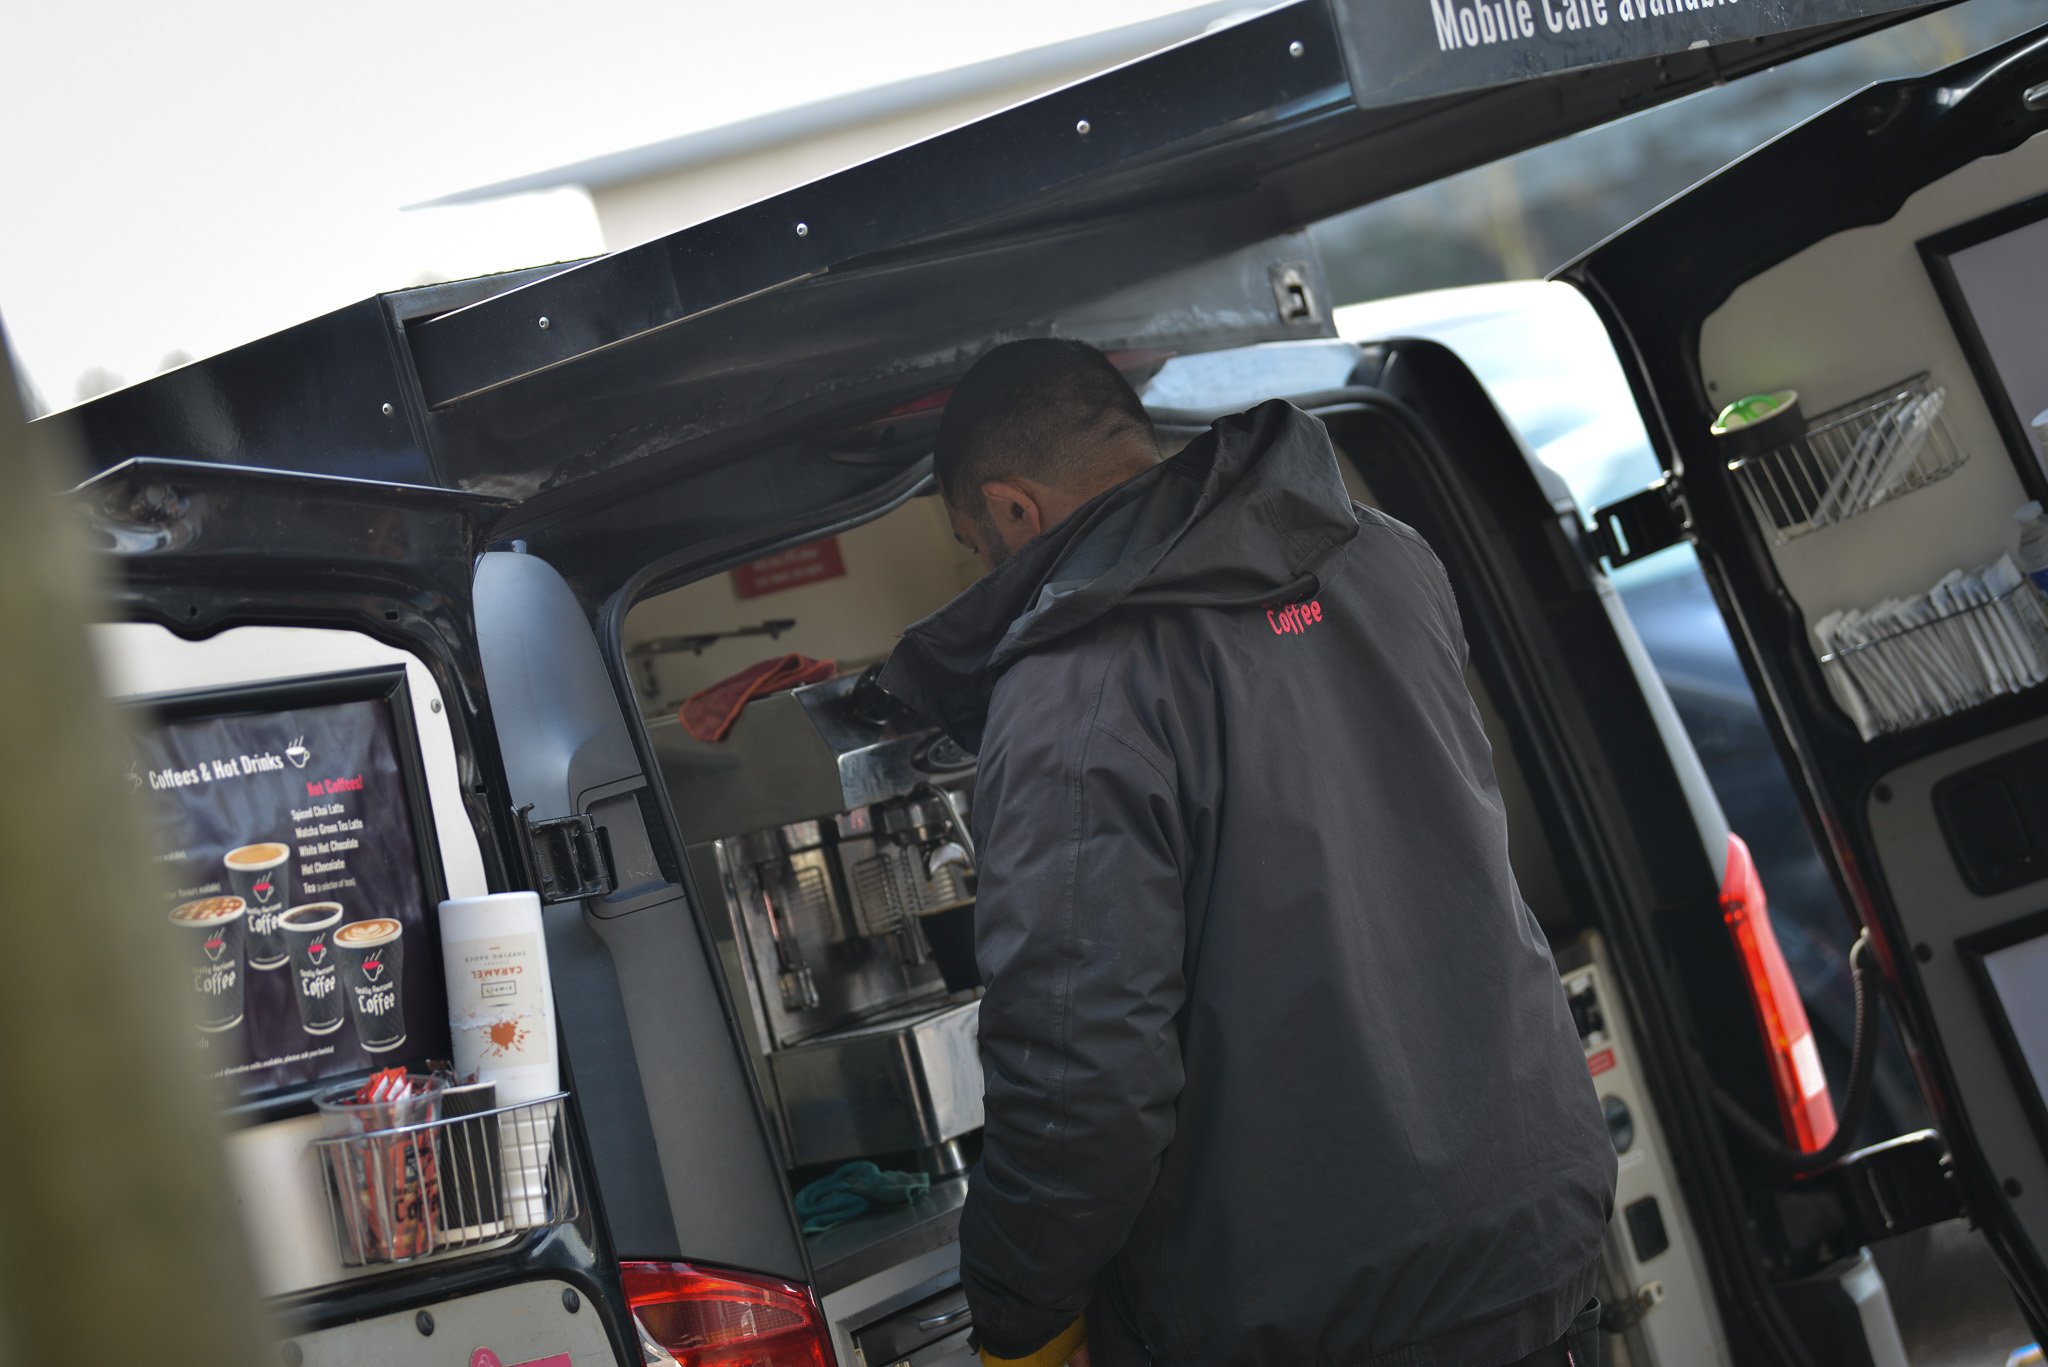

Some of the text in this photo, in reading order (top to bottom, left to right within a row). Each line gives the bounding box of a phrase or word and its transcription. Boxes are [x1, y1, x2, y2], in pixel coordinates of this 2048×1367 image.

[1430, 0, 1534, 51] Mobile
[1267, 600, 1323, 635] Coffee
[149, 752, 285, 790] Coffees & Hot Drinks
[328, 803, 345, 815] Latte
[348, 819, 364, 830] Latte
[194, 970, 236, 995] Coffee
[471, 965, 523, 980] CARAMEL
[302, 975, 336, 998] Coffee
[358, 992, 395, 1016] Coffee
